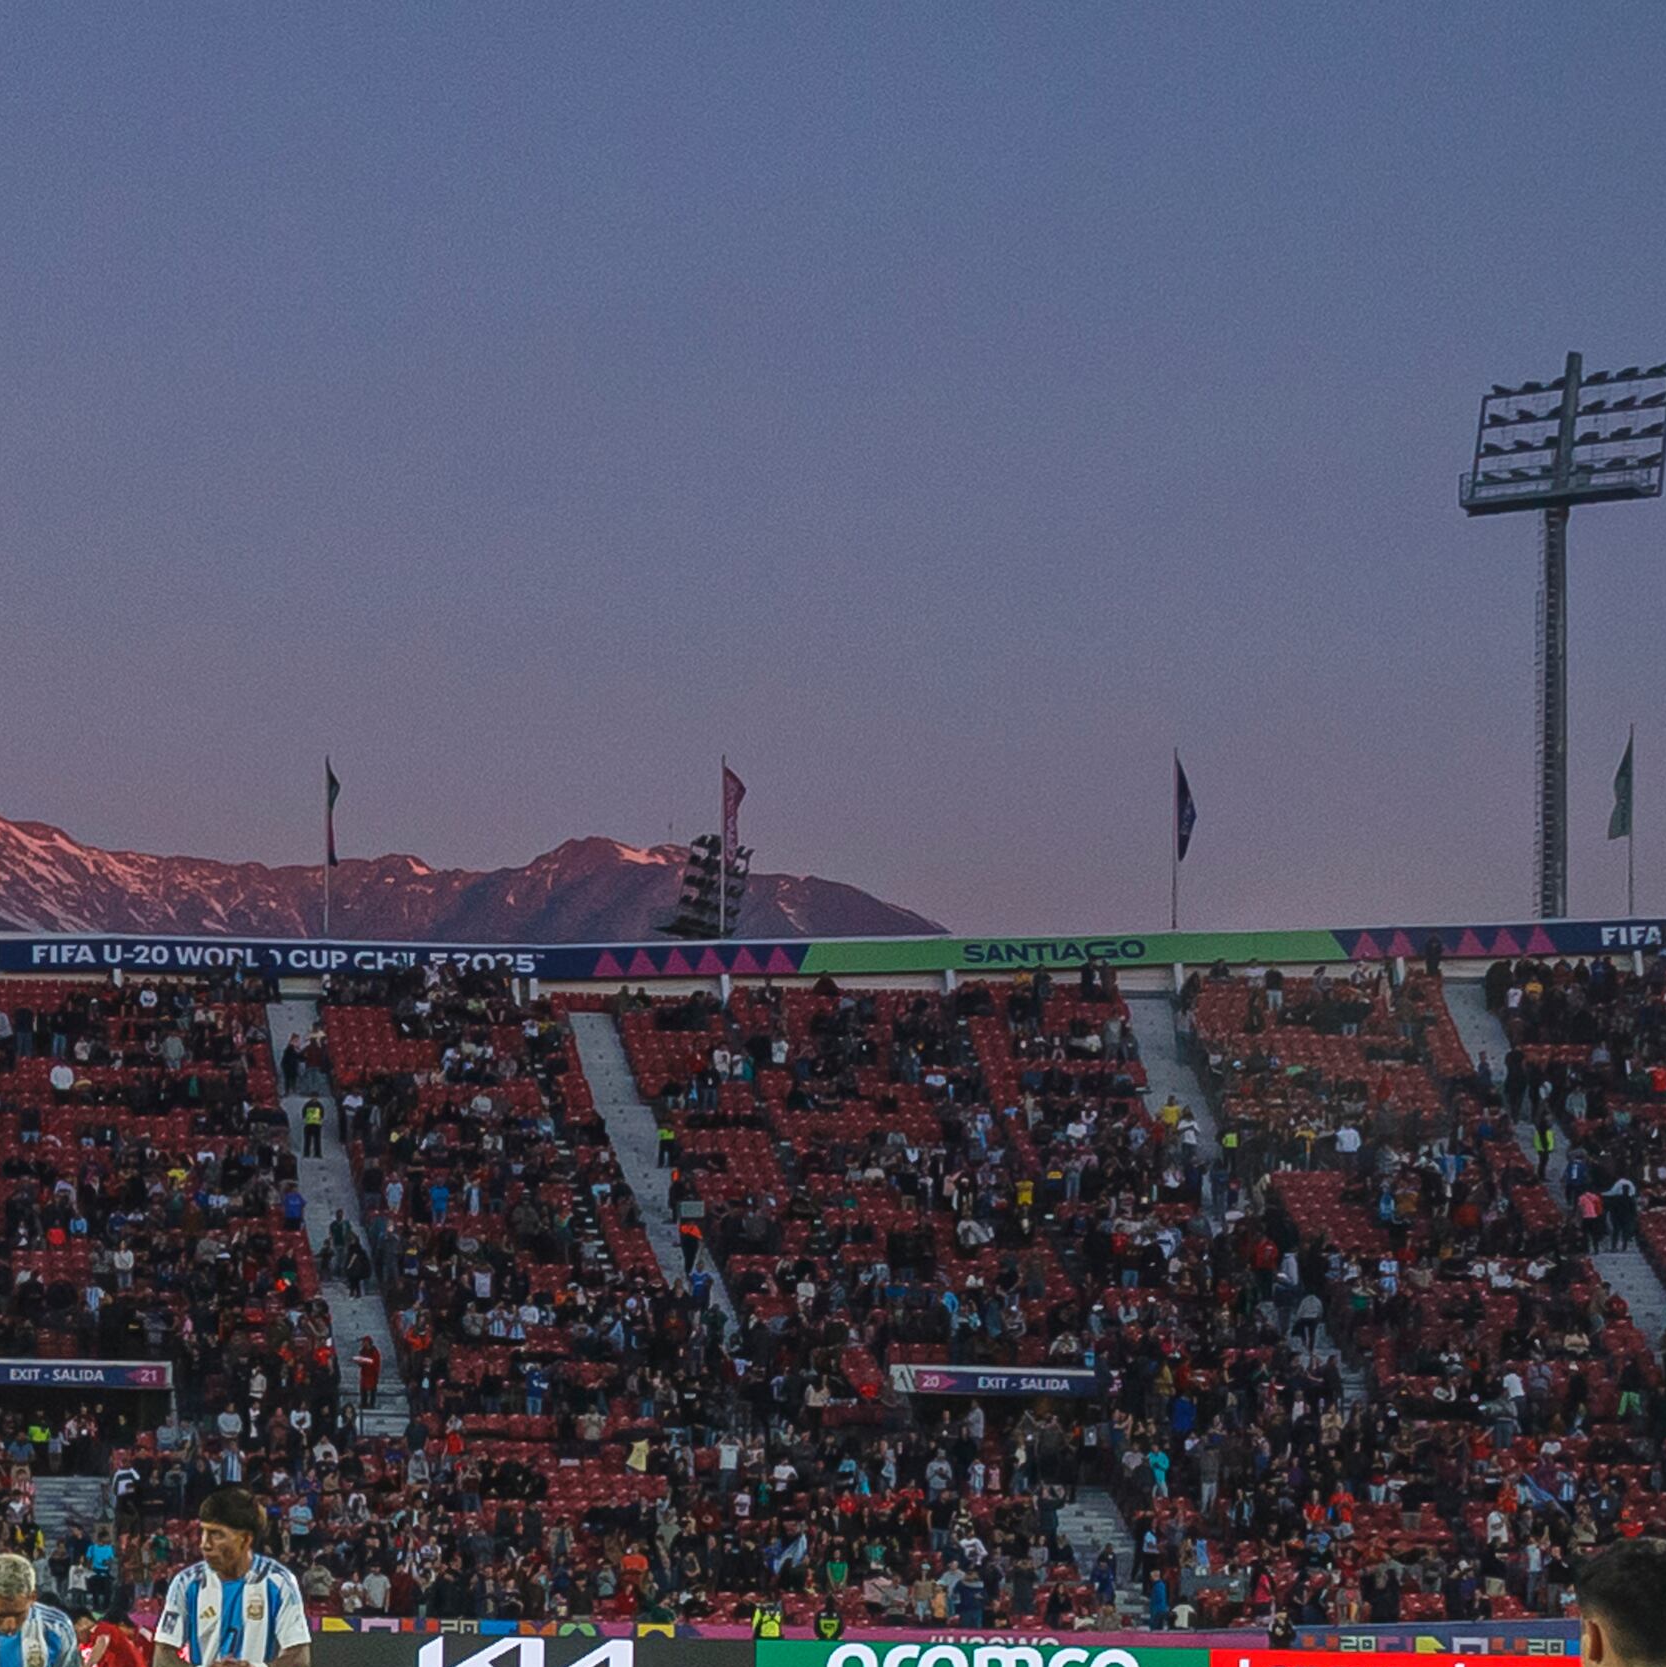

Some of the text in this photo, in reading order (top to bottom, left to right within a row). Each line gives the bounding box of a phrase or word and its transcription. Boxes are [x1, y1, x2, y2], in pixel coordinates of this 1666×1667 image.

[1600, 925, 1662, 946] FIFA
[32, 943, 97, 964] FIFA
[103, 944, 170, 965] U-20
[289, 949, 348, 969] CUP
[963, 940, 1146, 963] SANTIAGO
[9, 1368, 40, 1382] EXIT
[52, 1368, 105, 1383] SALIDA
[140, 1370, 158, 1382] 21
[923, 1376, 941, 1389] 20
[977, 1376, 1008, 1390] EXIT
[1019, 1376, 1070, 1391] SALIDA
